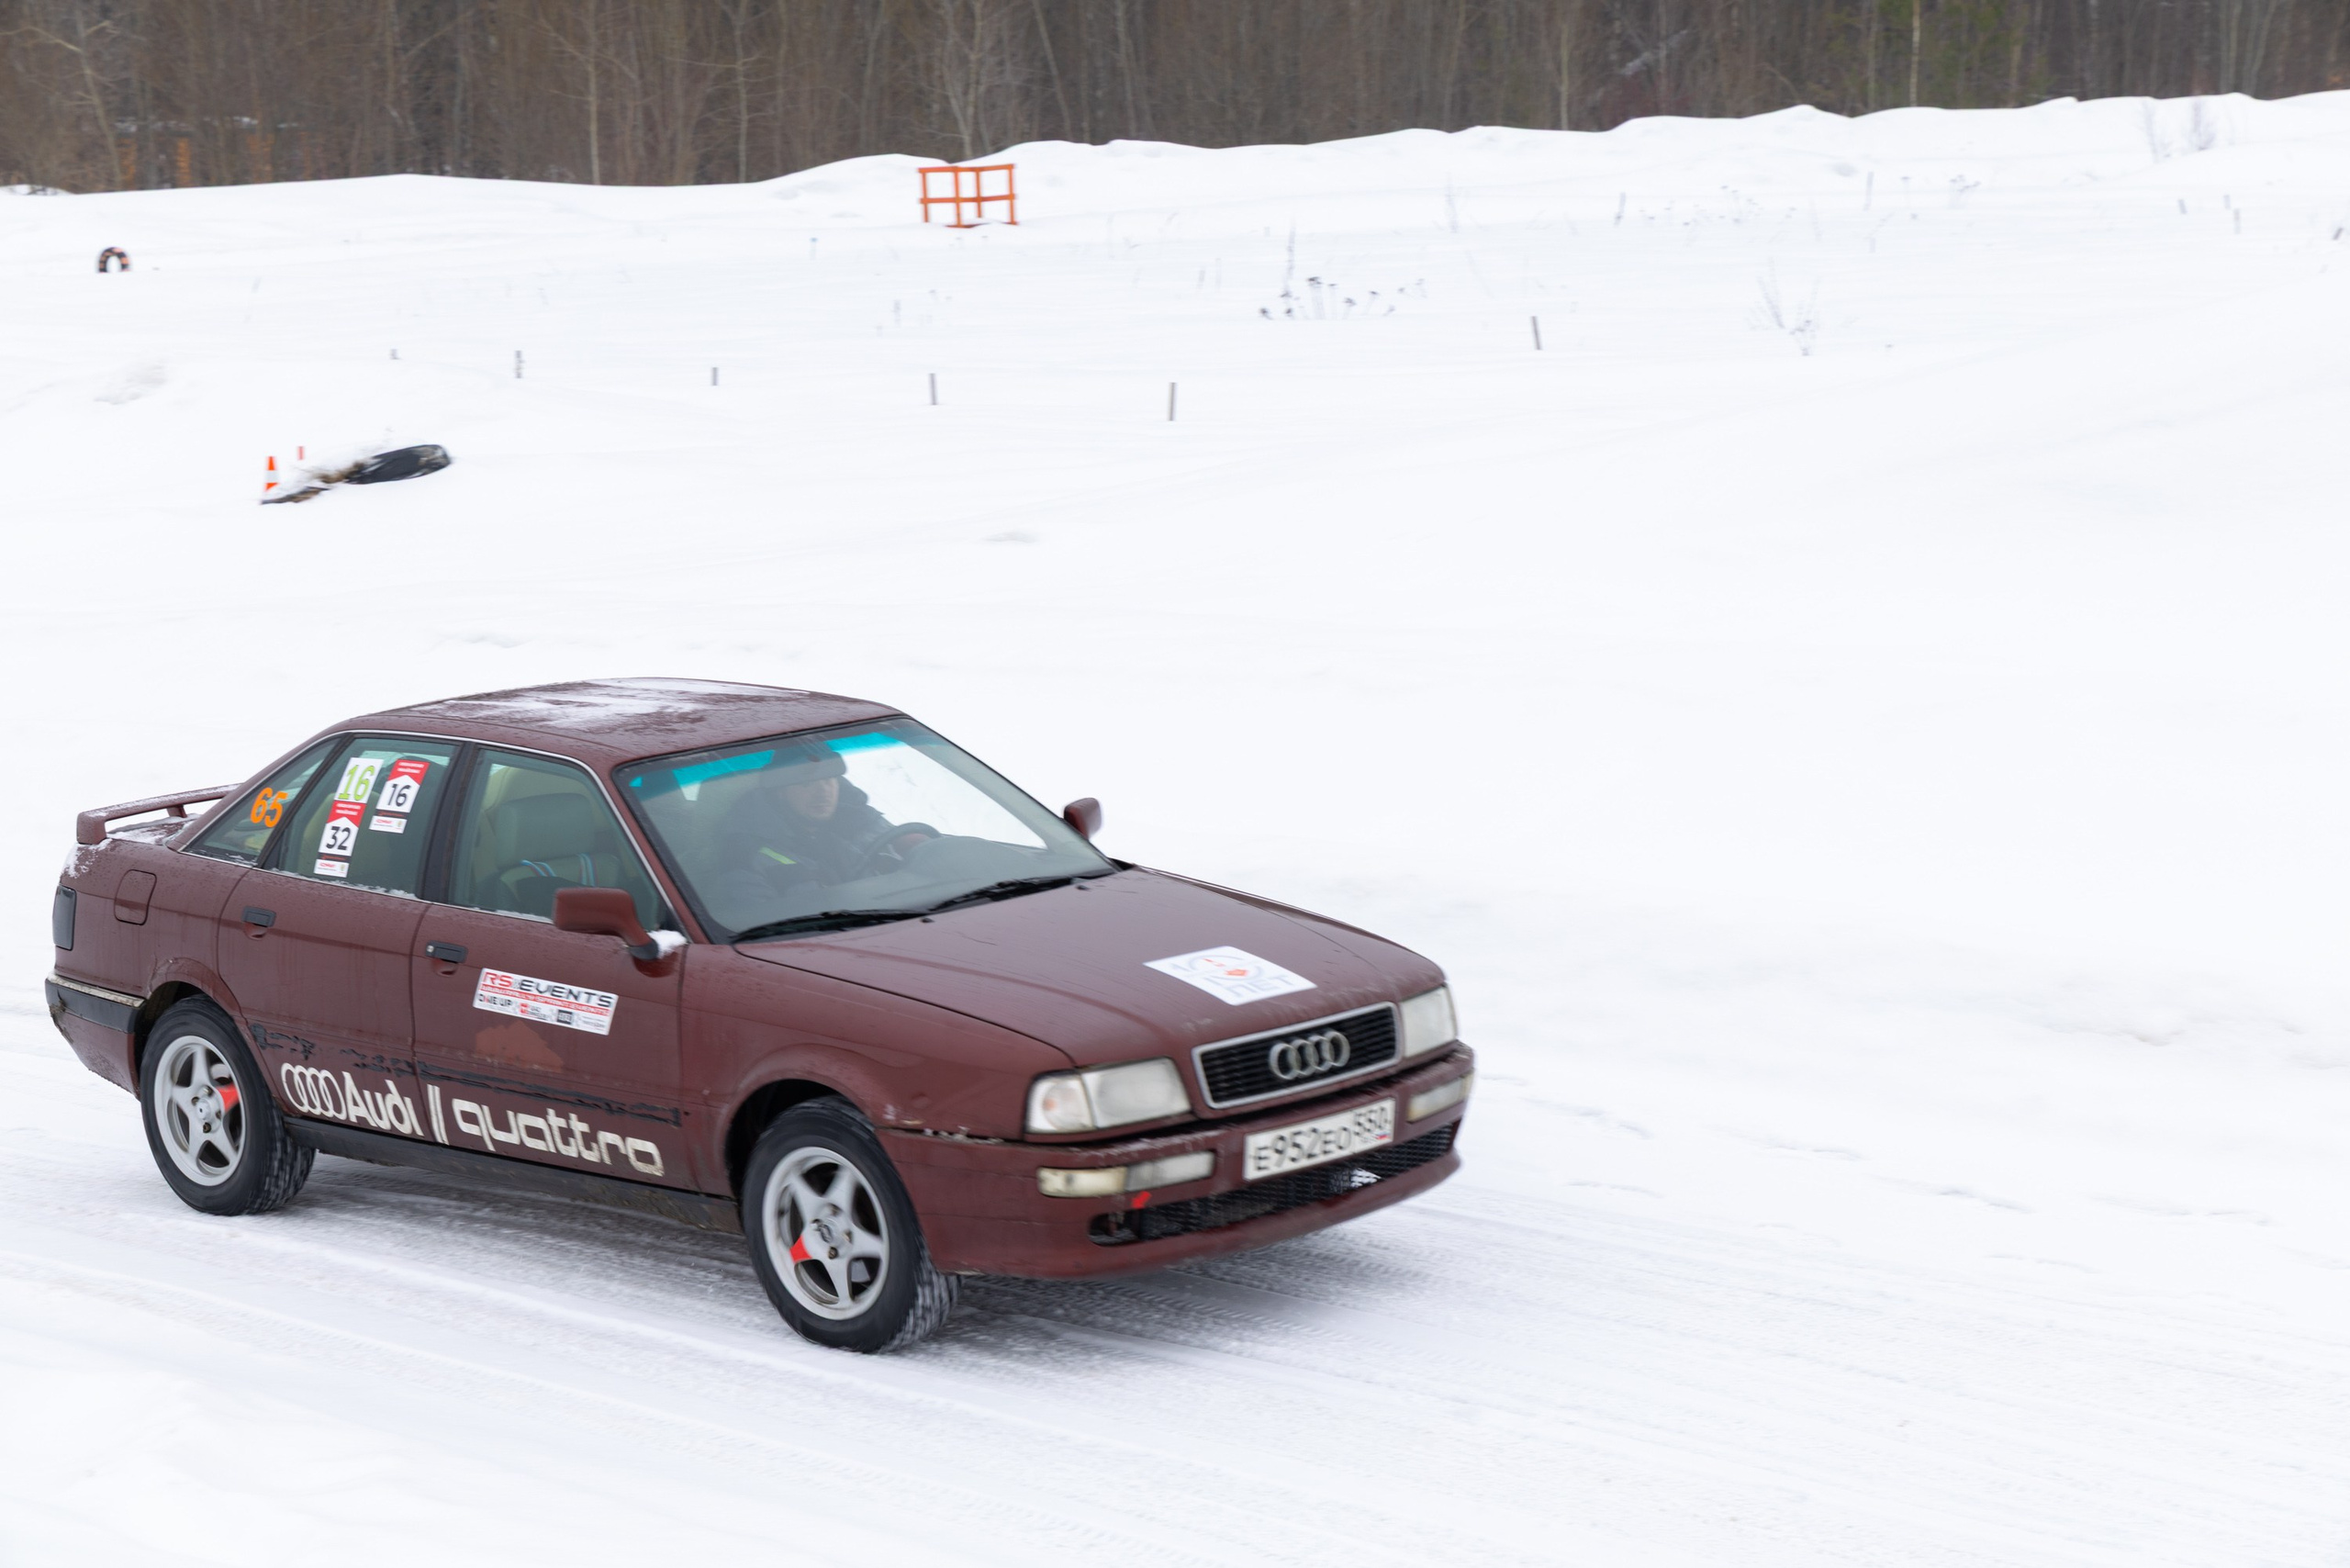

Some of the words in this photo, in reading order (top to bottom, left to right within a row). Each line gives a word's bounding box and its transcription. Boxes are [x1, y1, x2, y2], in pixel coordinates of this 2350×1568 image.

[338, 764, 375, 801] 16
[386, 783, 411, 807] 16
[251, 787, 288, 827] 65
[326, 825, 351, 851] 32
[482, 971, 514, 988] RS
[519, 979, 614, 1008] EVENTS
[341, 1071, 424, 1137] Audi
[452, 1098, 665, 1178] quattro
